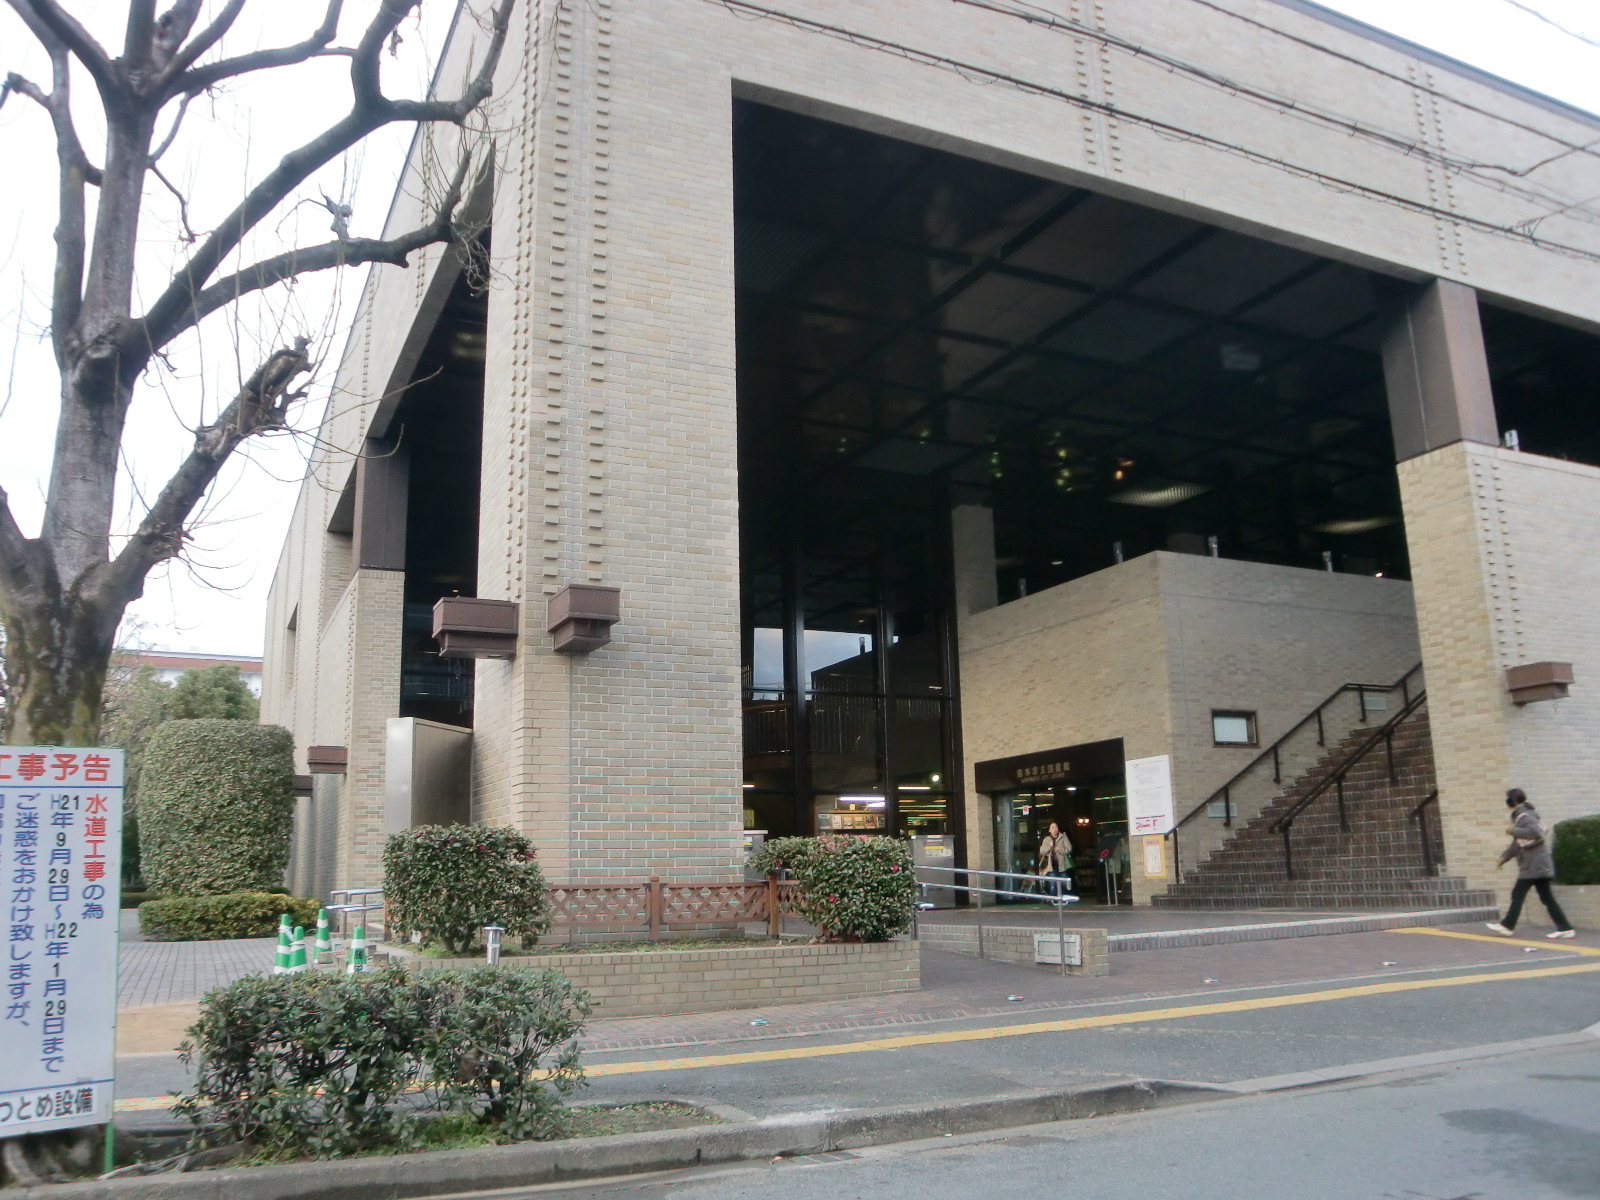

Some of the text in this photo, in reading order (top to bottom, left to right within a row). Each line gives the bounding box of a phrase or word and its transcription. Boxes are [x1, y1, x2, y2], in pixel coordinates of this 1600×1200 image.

[81, 793, 109, 920] 水道工事の為
